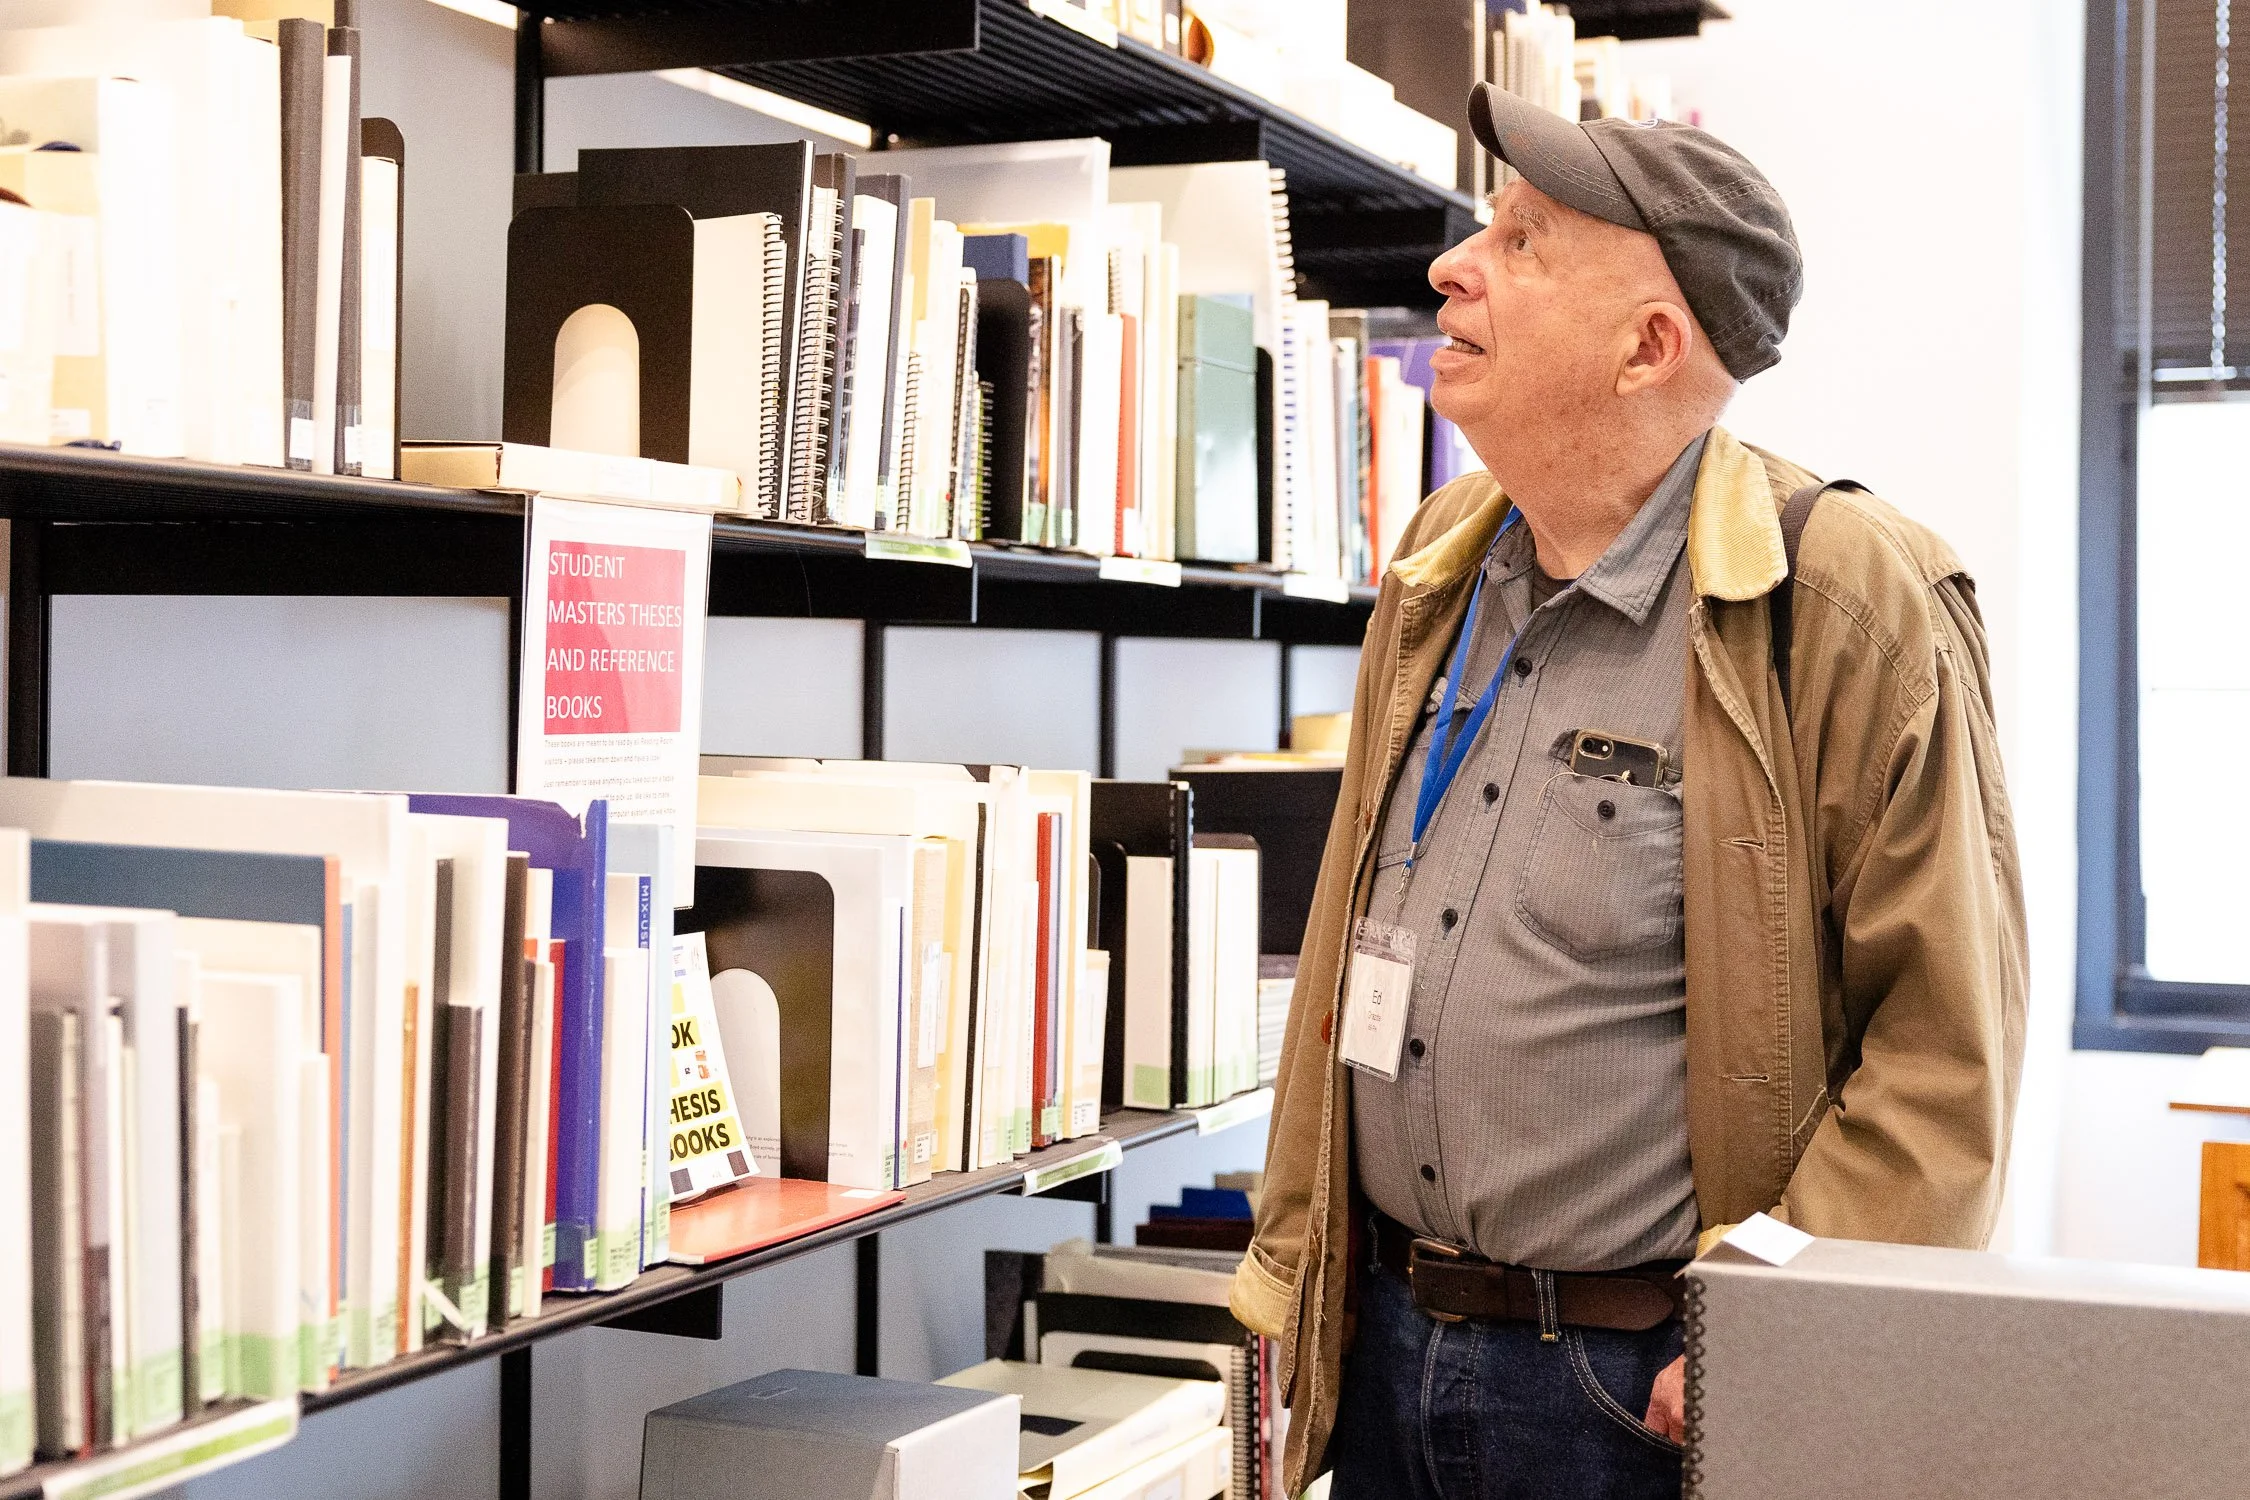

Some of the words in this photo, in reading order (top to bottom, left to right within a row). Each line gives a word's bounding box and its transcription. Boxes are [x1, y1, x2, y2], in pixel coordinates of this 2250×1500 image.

[549, 551, 625, 579] STUDENT
[548, 601, 626, 626] MASTERS
[629, 603, 682, 628] THESES
[546, 648, 585, 672] AND
[590, 649, 675, 673] REFERENCE
[546, 695, 602, 719] BOOKS
[670, 1122, 730, 1162] OOKS
